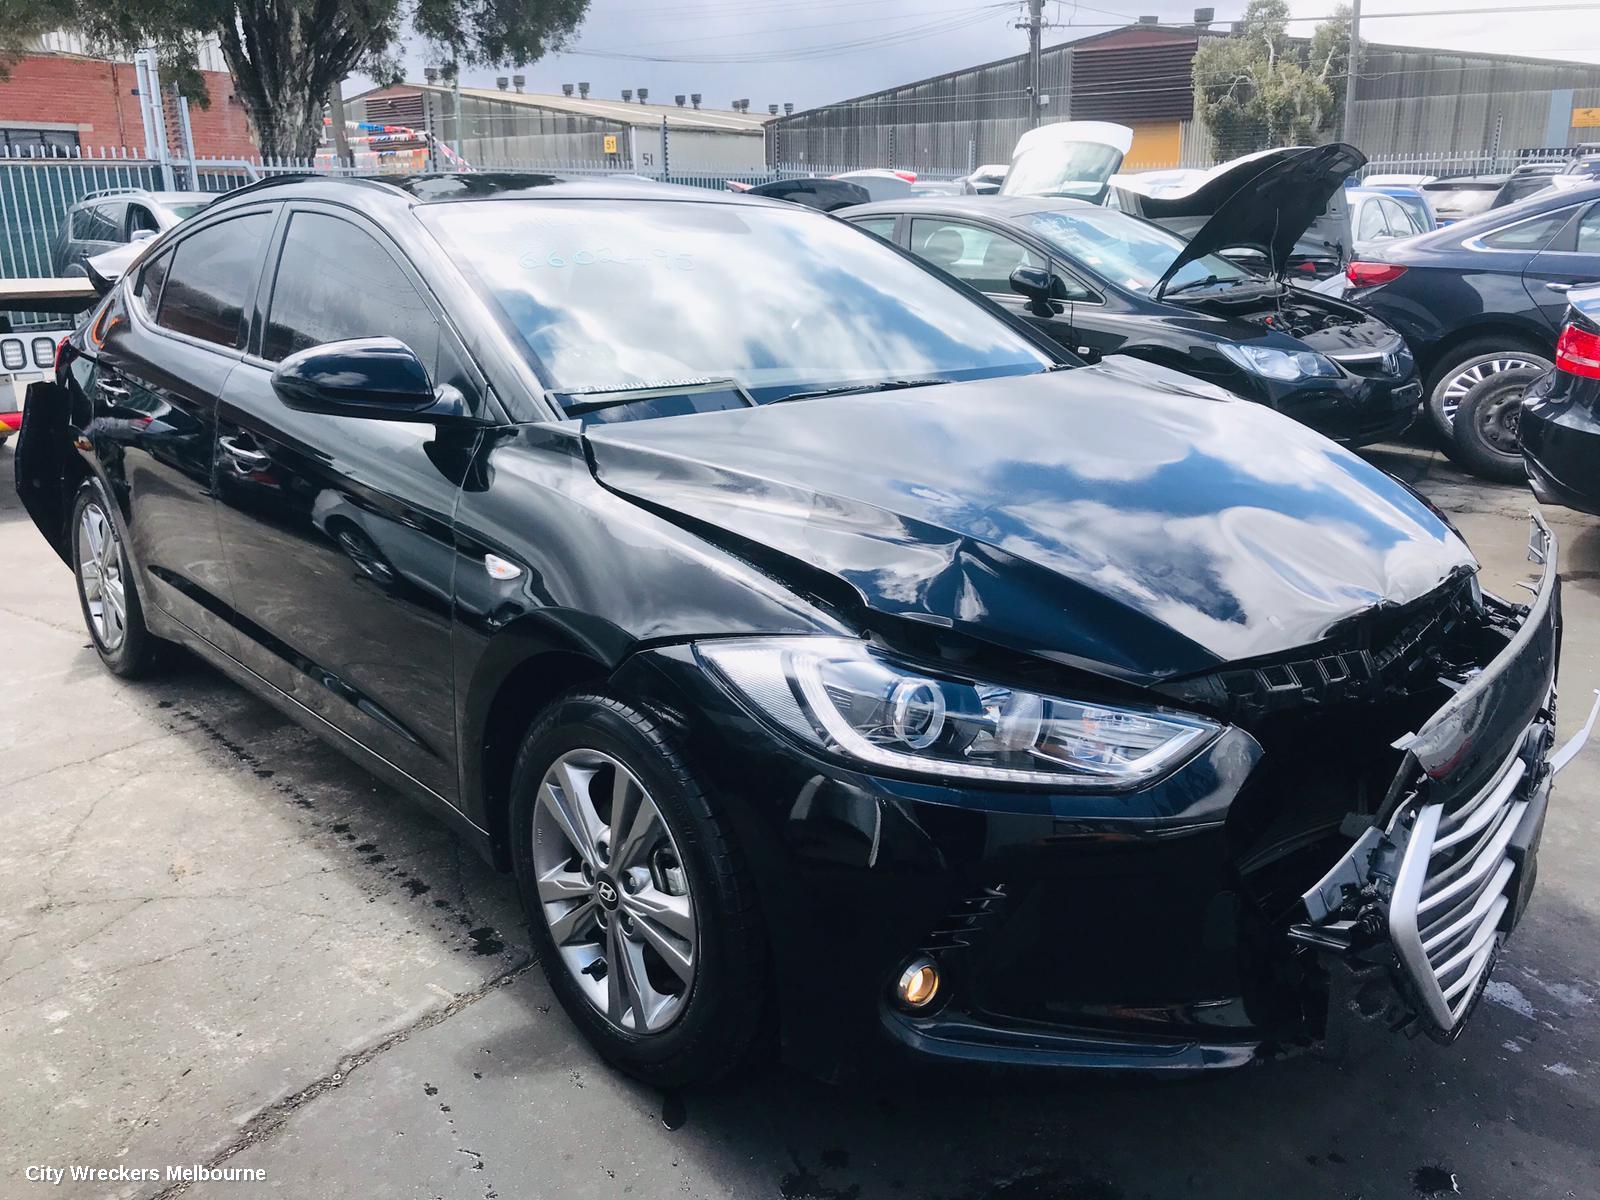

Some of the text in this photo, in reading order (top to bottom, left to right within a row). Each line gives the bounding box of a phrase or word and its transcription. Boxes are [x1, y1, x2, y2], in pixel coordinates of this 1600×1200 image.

[605, 139, 615, 150] 51
[642, 153, 653, 166] 51
[593, 382, 645, 392] HYUNDAI
[645, 376, 712, 388] CHADSTONE
